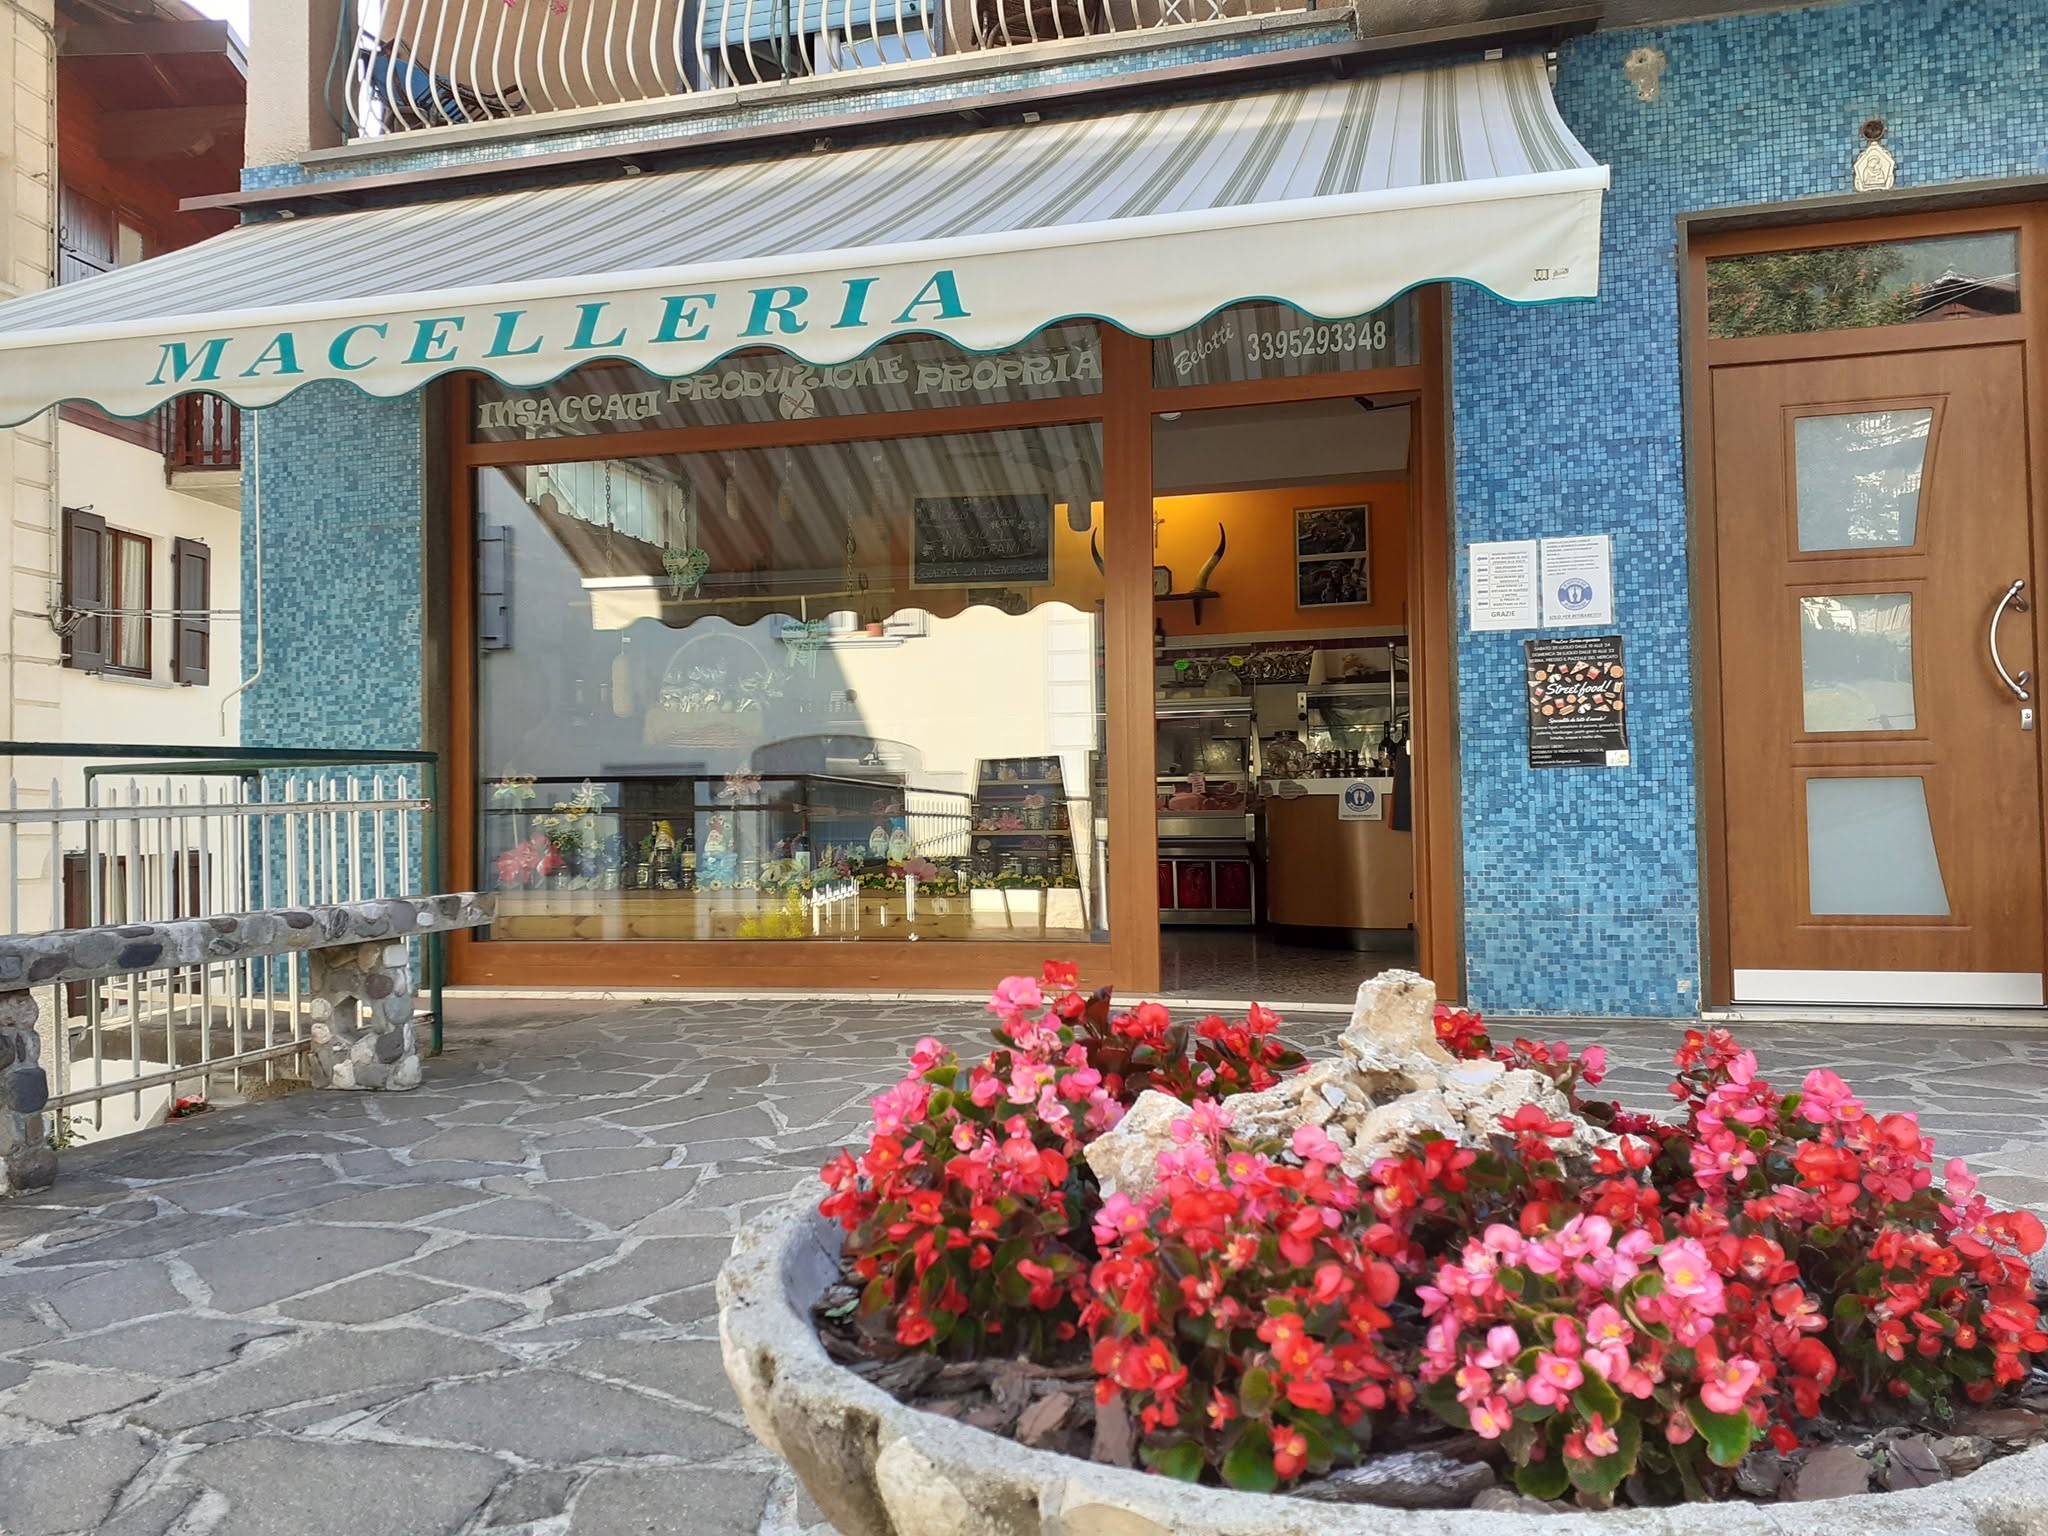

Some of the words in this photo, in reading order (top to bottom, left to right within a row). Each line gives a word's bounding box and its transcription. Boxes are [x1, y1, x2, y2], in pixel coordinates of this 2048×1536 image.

[146, 269, 972, 386] MACELLERIA
[1174, 323, 1234, 375] Belotti
[1248, 321, 1386, 361] 3395293348
[478, 390, 661, 428] INSACCATI
[667, 355, 909, 403] PRODUZIONE
[915, 350, 1102, 394] PROPRIA
[1491, 610, 1516, 618] GRAZIE
[1545, 683, 1581, 695] Street
[1577, 680, 1613, 697] food!
